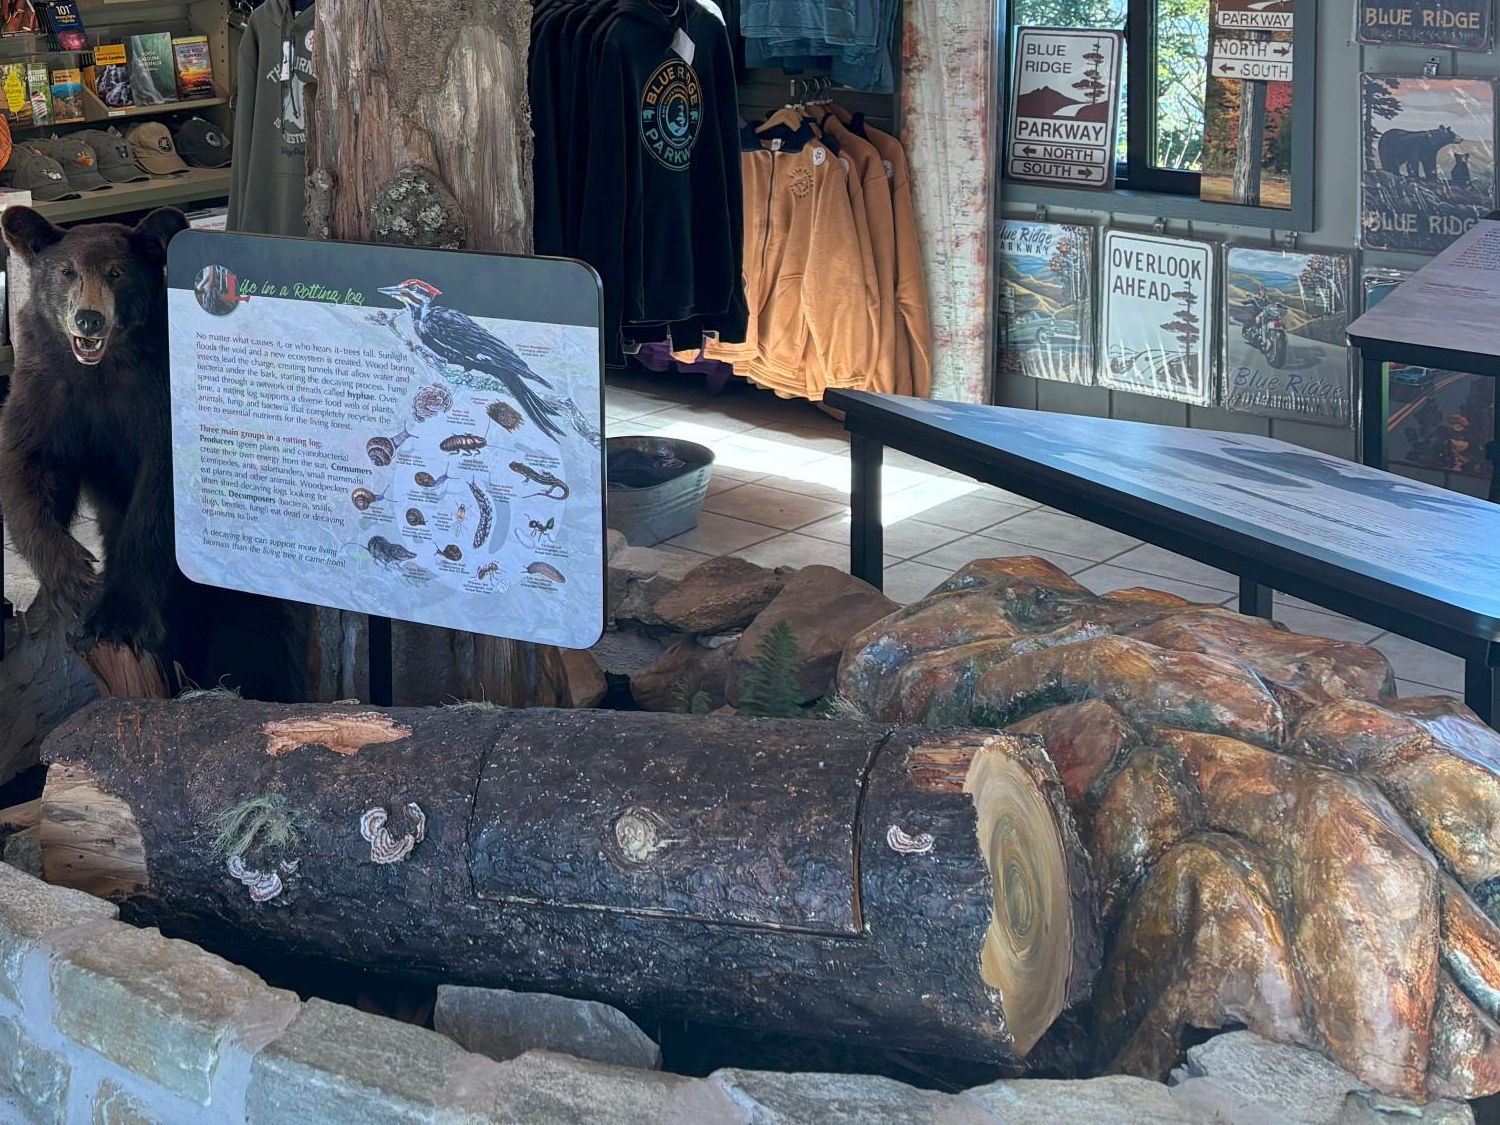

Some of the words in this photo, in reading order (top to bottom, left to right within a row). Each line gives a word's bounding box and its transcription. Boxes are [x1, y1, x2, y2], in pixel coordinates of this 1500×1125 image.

[56, 5, 70, 15] 101
[1365, 9, 1413, 26] BLUE
[1422, 10, 1480, 29] RIDGE
[1222, 13, 1291, 26] PARKWAY
[1027, 44, 1066, 57] BLUE
[1218, 43, 1267, 57] NORTH
[1025, 61, 1072, 74] RIDGE
[1243, 64, 1288, 78] SOUTH
[647, 67, 675, 104] BLUE
[1018, 121, 1103, 142] PARKWAY
[1043, 147, 1093, 161] NORTH
[1023, 163, 1071, 177] SOUTH
[1368, 211, 1417, 232] BLUE
[1428, 215, 1476, 235] RIDG
[1020, 227, 1052, 244] Ridge
[1000, 241, 1049, 255] ARKWAY
[1113, 248, 1202, 280] OVERLOOK
[261, 280, 276, 295] in
[280, 286, 289, 296] a
[293, 283, 340, 307] Rotting
[1113, 275, 1170, 302] AHEAD
[196, 331, 207, 339] No
[209, 333, 230, 342] matter
[232, 335, 249, 344] what
[295, 342, 310, 350] who
[313, 343, 332, 354] hears
[363, 349, 376, 358] fall.
[378, 350, 407, 362] Sunlight
[1234, 367, 1279, 391] Blue
[1285, 373, 1343, 399] Ridge
[200, 424, 219, 434] Three
[221, 427, 239, 436] main
[240, 431, 265, 440] groups
[266, 433, 274, 441] in
[283, 436, 307, 447] rotting
[309, 438, 322, 449] log:
[200, 435, 234, 446] Producers
[210, 528, 240, 541] decaying
[242, 532, 253, 543] log
[255, 536, 267, 544] can
[270, 537, 296, 549] support
[298, 543, 317, 552] more
[319, 545, 337, 557] living
